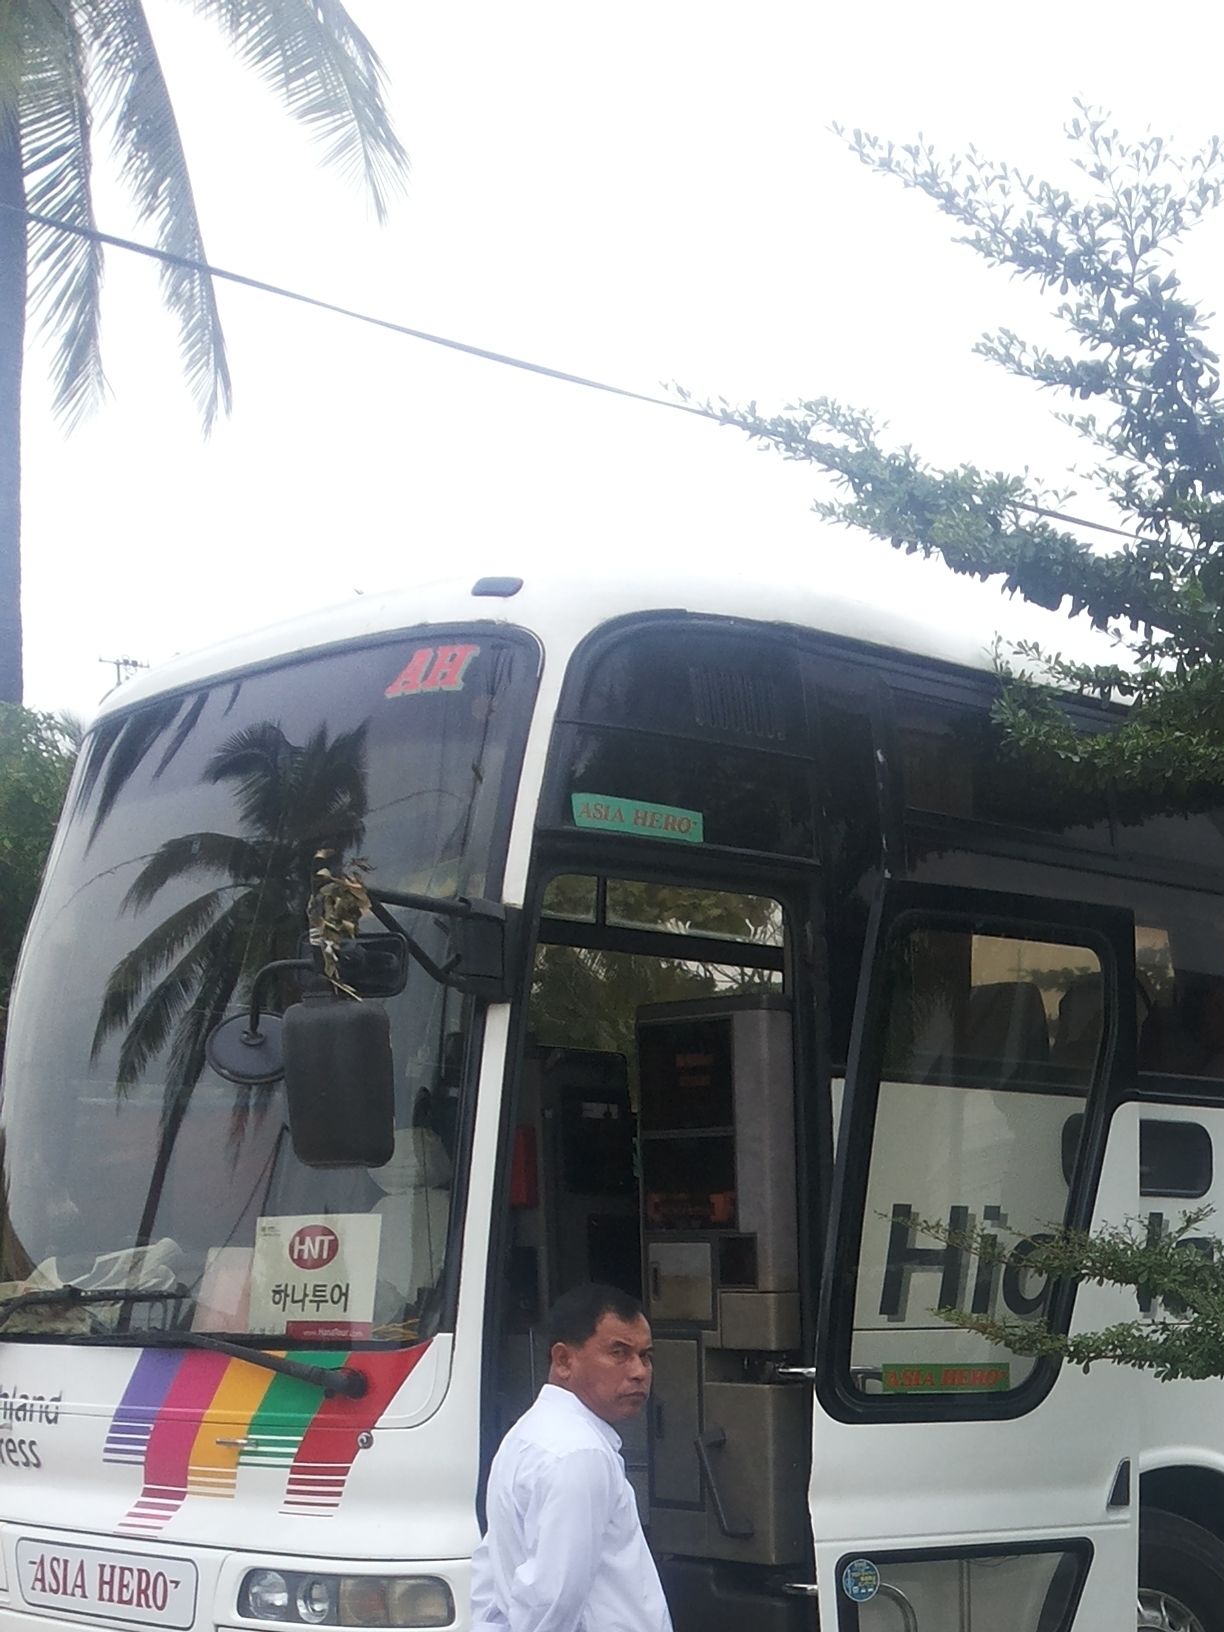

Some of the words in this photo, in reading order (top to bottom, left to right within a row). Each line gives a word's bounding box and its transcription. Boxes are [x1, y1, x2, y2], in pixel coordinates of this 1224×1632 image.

[384, 645, 480, 699] AH
[578, 802, 626, 824] ASIA
[632, 808, 693, 834] HERO
[293, 1235, 336, 1260] HNT
[271, 1282, 350, 1313] 하나투어
[30, 1553, 89, 1599] ASIA
[97, 1562, 169, 1612] HERO
